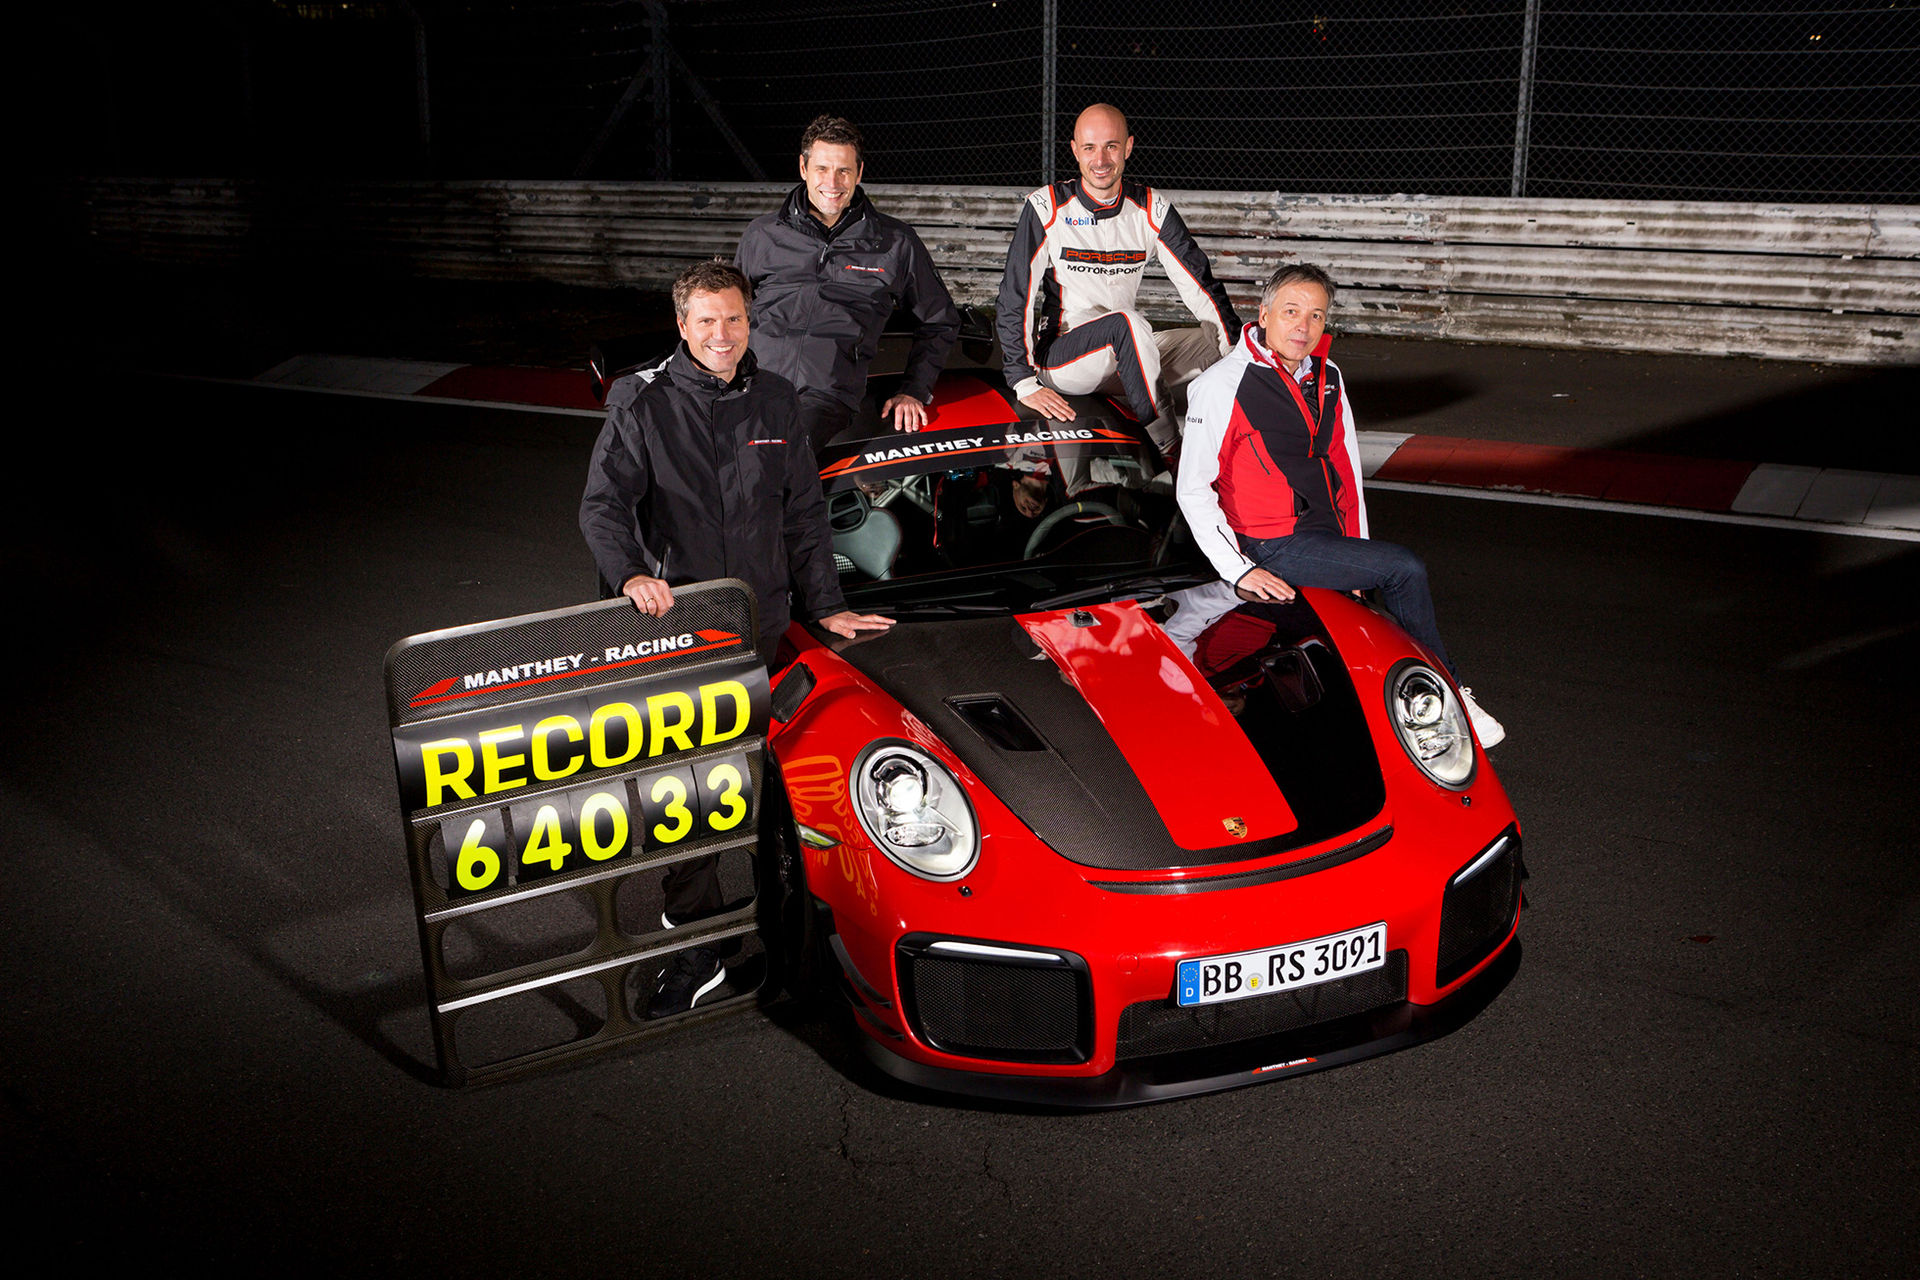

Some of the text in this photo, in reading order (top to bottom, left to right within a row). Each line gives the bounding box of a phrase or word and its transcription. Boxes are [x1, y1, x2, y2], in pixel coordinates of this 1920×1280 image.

[1065, 216, 1089, 226] Mobil
[1066, 250, 1146, 262] PORSCHE
[1067, 264, 1143, 275] MOTORSPORT
[865, 437, 983, 464] MANTHEY
[1004, 428, 1094, 444] RACING
[463, 652, 584, 691] MANTHEY
[605, 632, 695, 663] RACING
[420, 680, 751, 808] RECORD
[456, 818, 500, 891] 6
[1203, 931, 1382, 997] BB RS 3091
[1185, 987, 1194, 998] D
